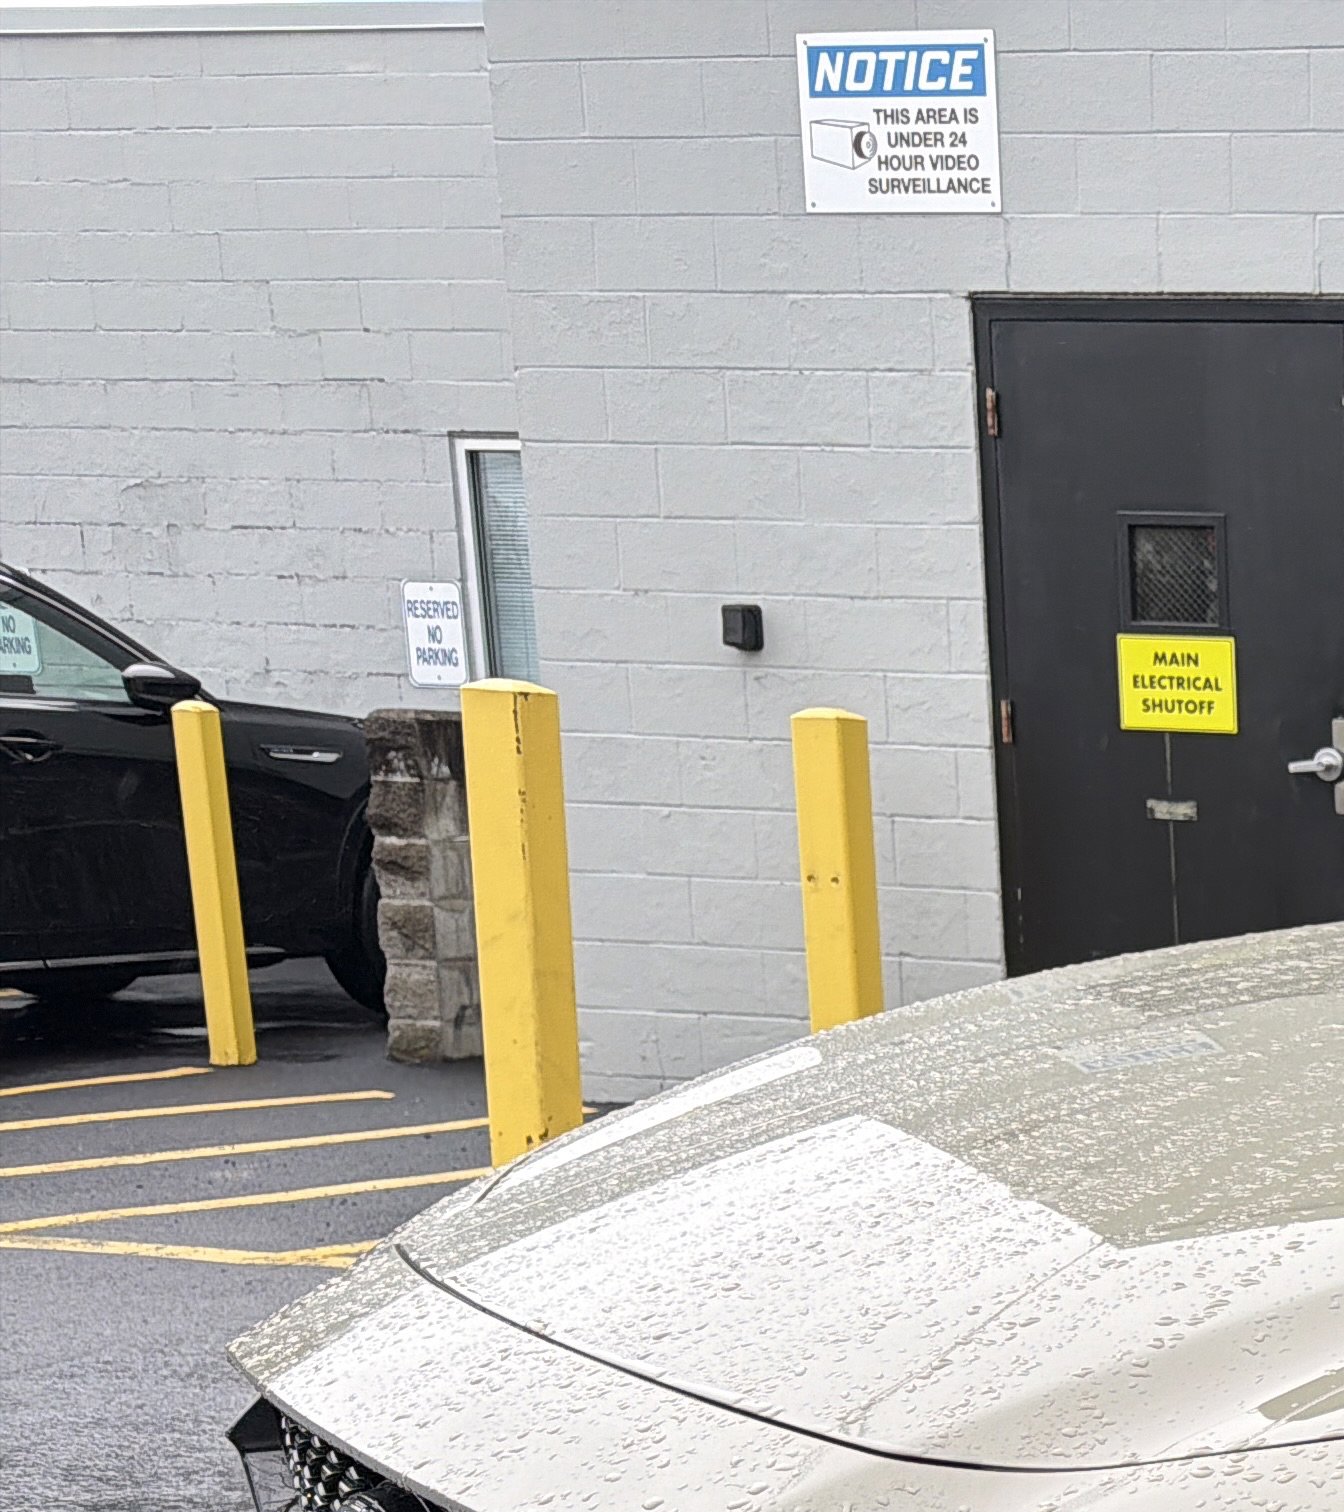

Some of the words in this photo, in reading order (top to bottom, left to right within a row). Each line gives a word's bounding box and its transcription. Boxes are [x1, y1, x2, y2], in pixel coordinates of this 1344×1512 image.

[814, 49, 979, 92] NOTICE
[873, 107, 910, 125] THIS
[915, 107, 959, 125] AREA
[964, 107, 979, 125] IS
[887, 131, 945, 148] UNDER
[949, 131, 968, 148] 24
[877, 154, 925, 171] HOUR
[929, 154, 979, 171] VIDEO
[868, 177, 992, 194] SURVEILLANCE
[406, 599, 459, 620] RESERVED
[1, 614, 16, 634] NO
[427, 624, 443, 645] NO
[416, 647, 459, 667] PARKING
[1153, 651, 1199, 667] MAIN
[1132, 674, 1222, 692] ELECTRICAL
[1142, 698, 1215, 715] SHUTOFF
